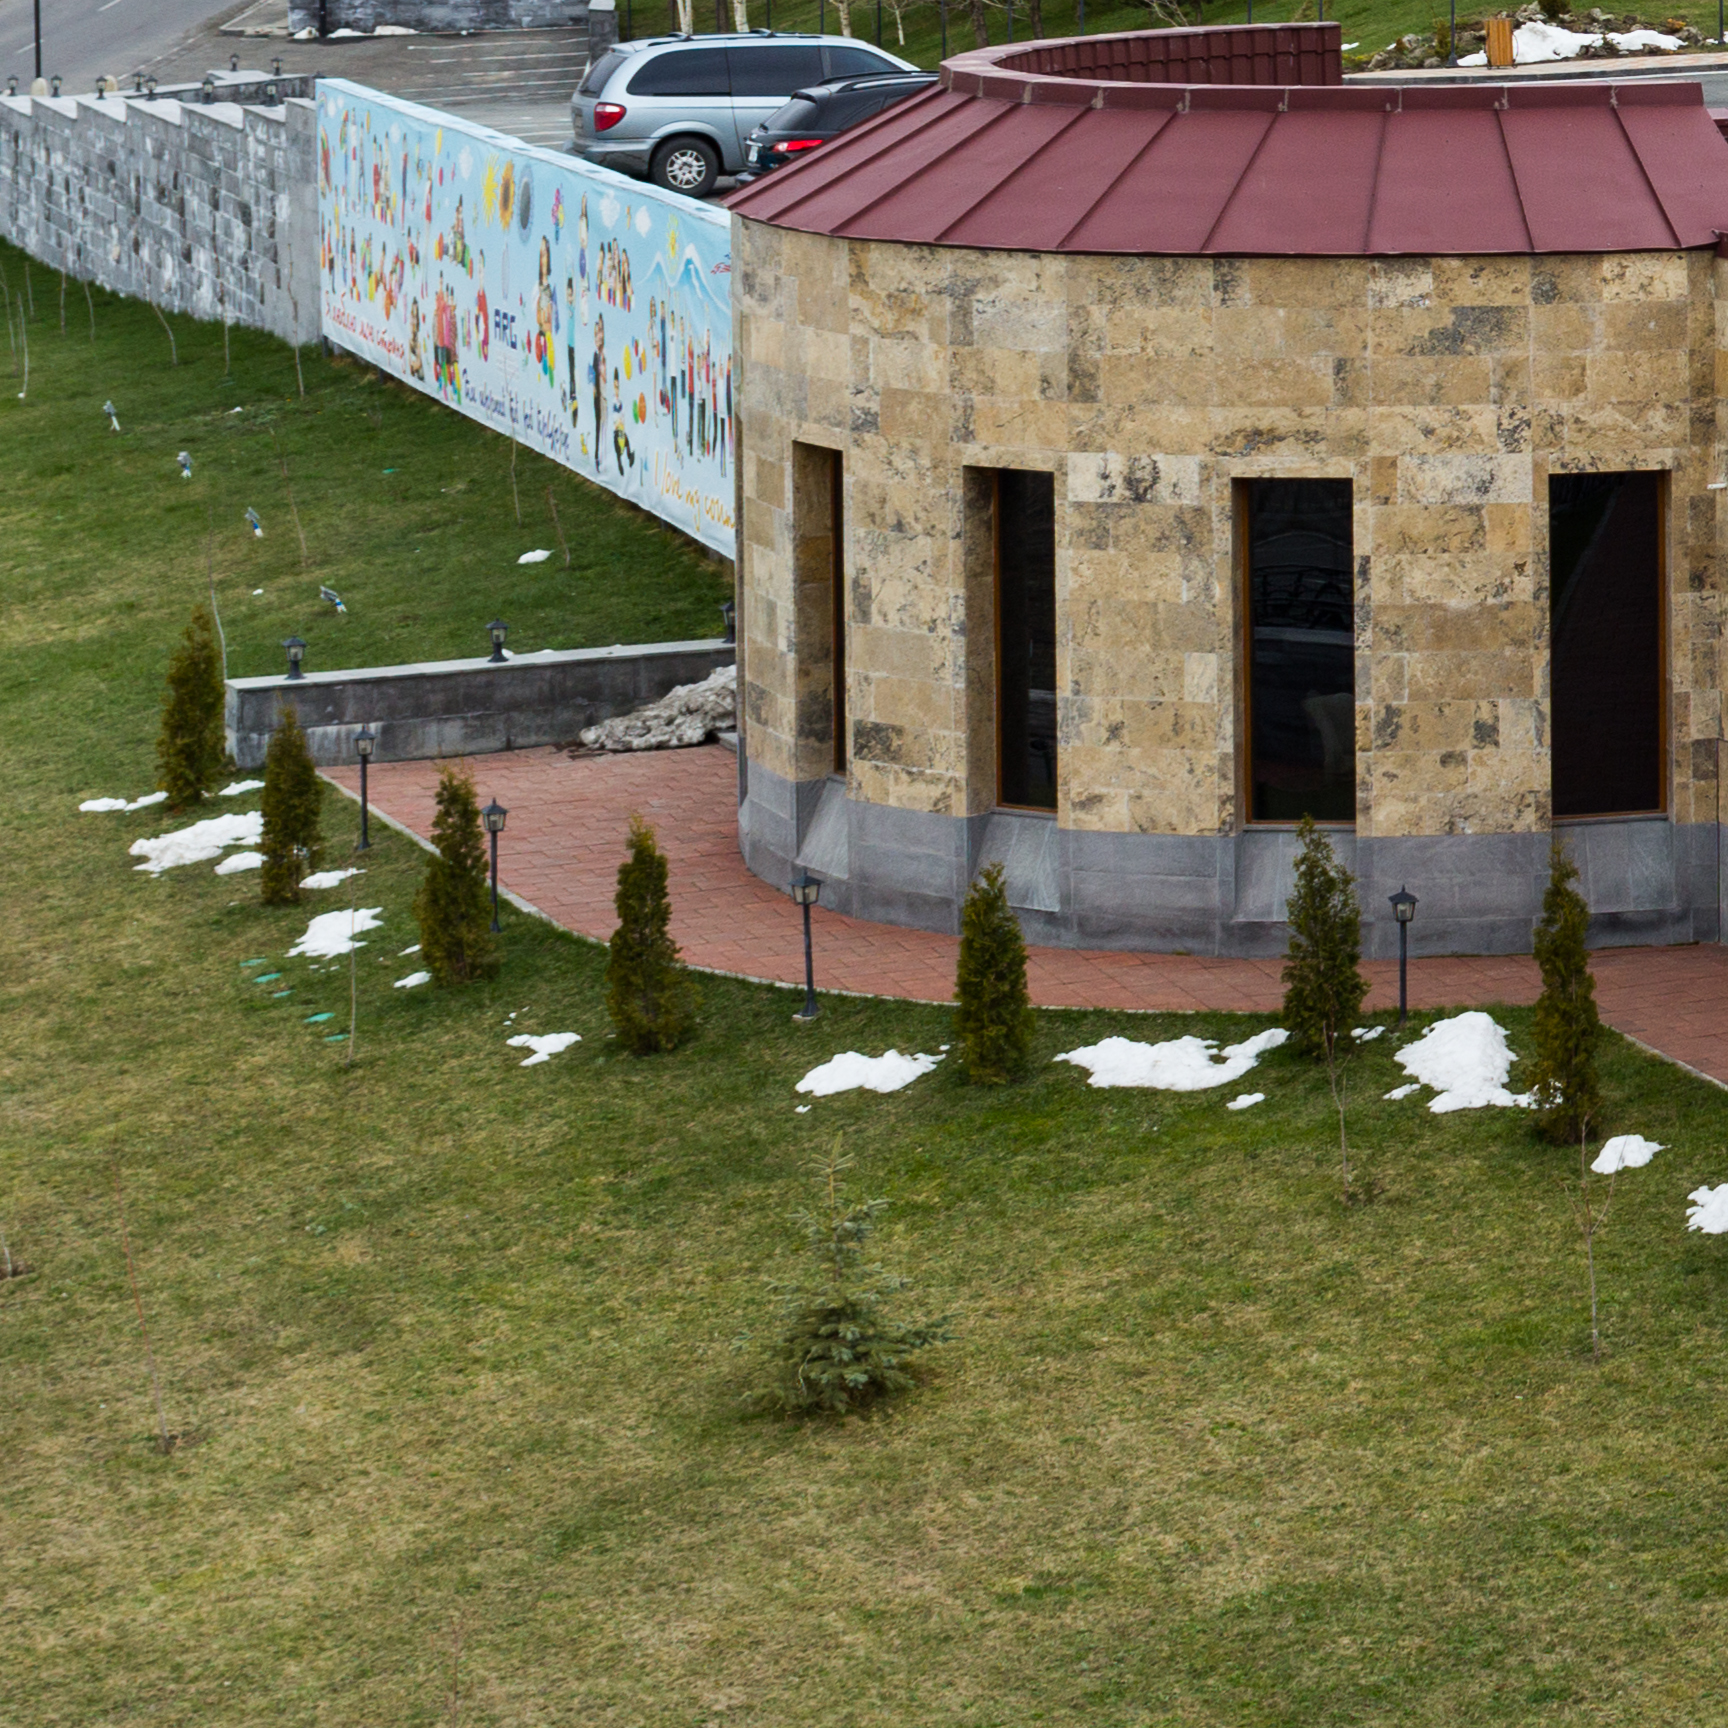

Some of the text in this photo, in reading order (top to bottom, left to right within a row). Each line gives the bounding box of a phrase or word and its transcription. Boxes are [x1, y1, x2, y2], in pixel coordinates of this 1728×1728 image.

[494, 308, 518, 350] ARG
[660, 451, 682, 500] love
[685, 489, 701, 533] my
[704, 495, 736, 529] coun
